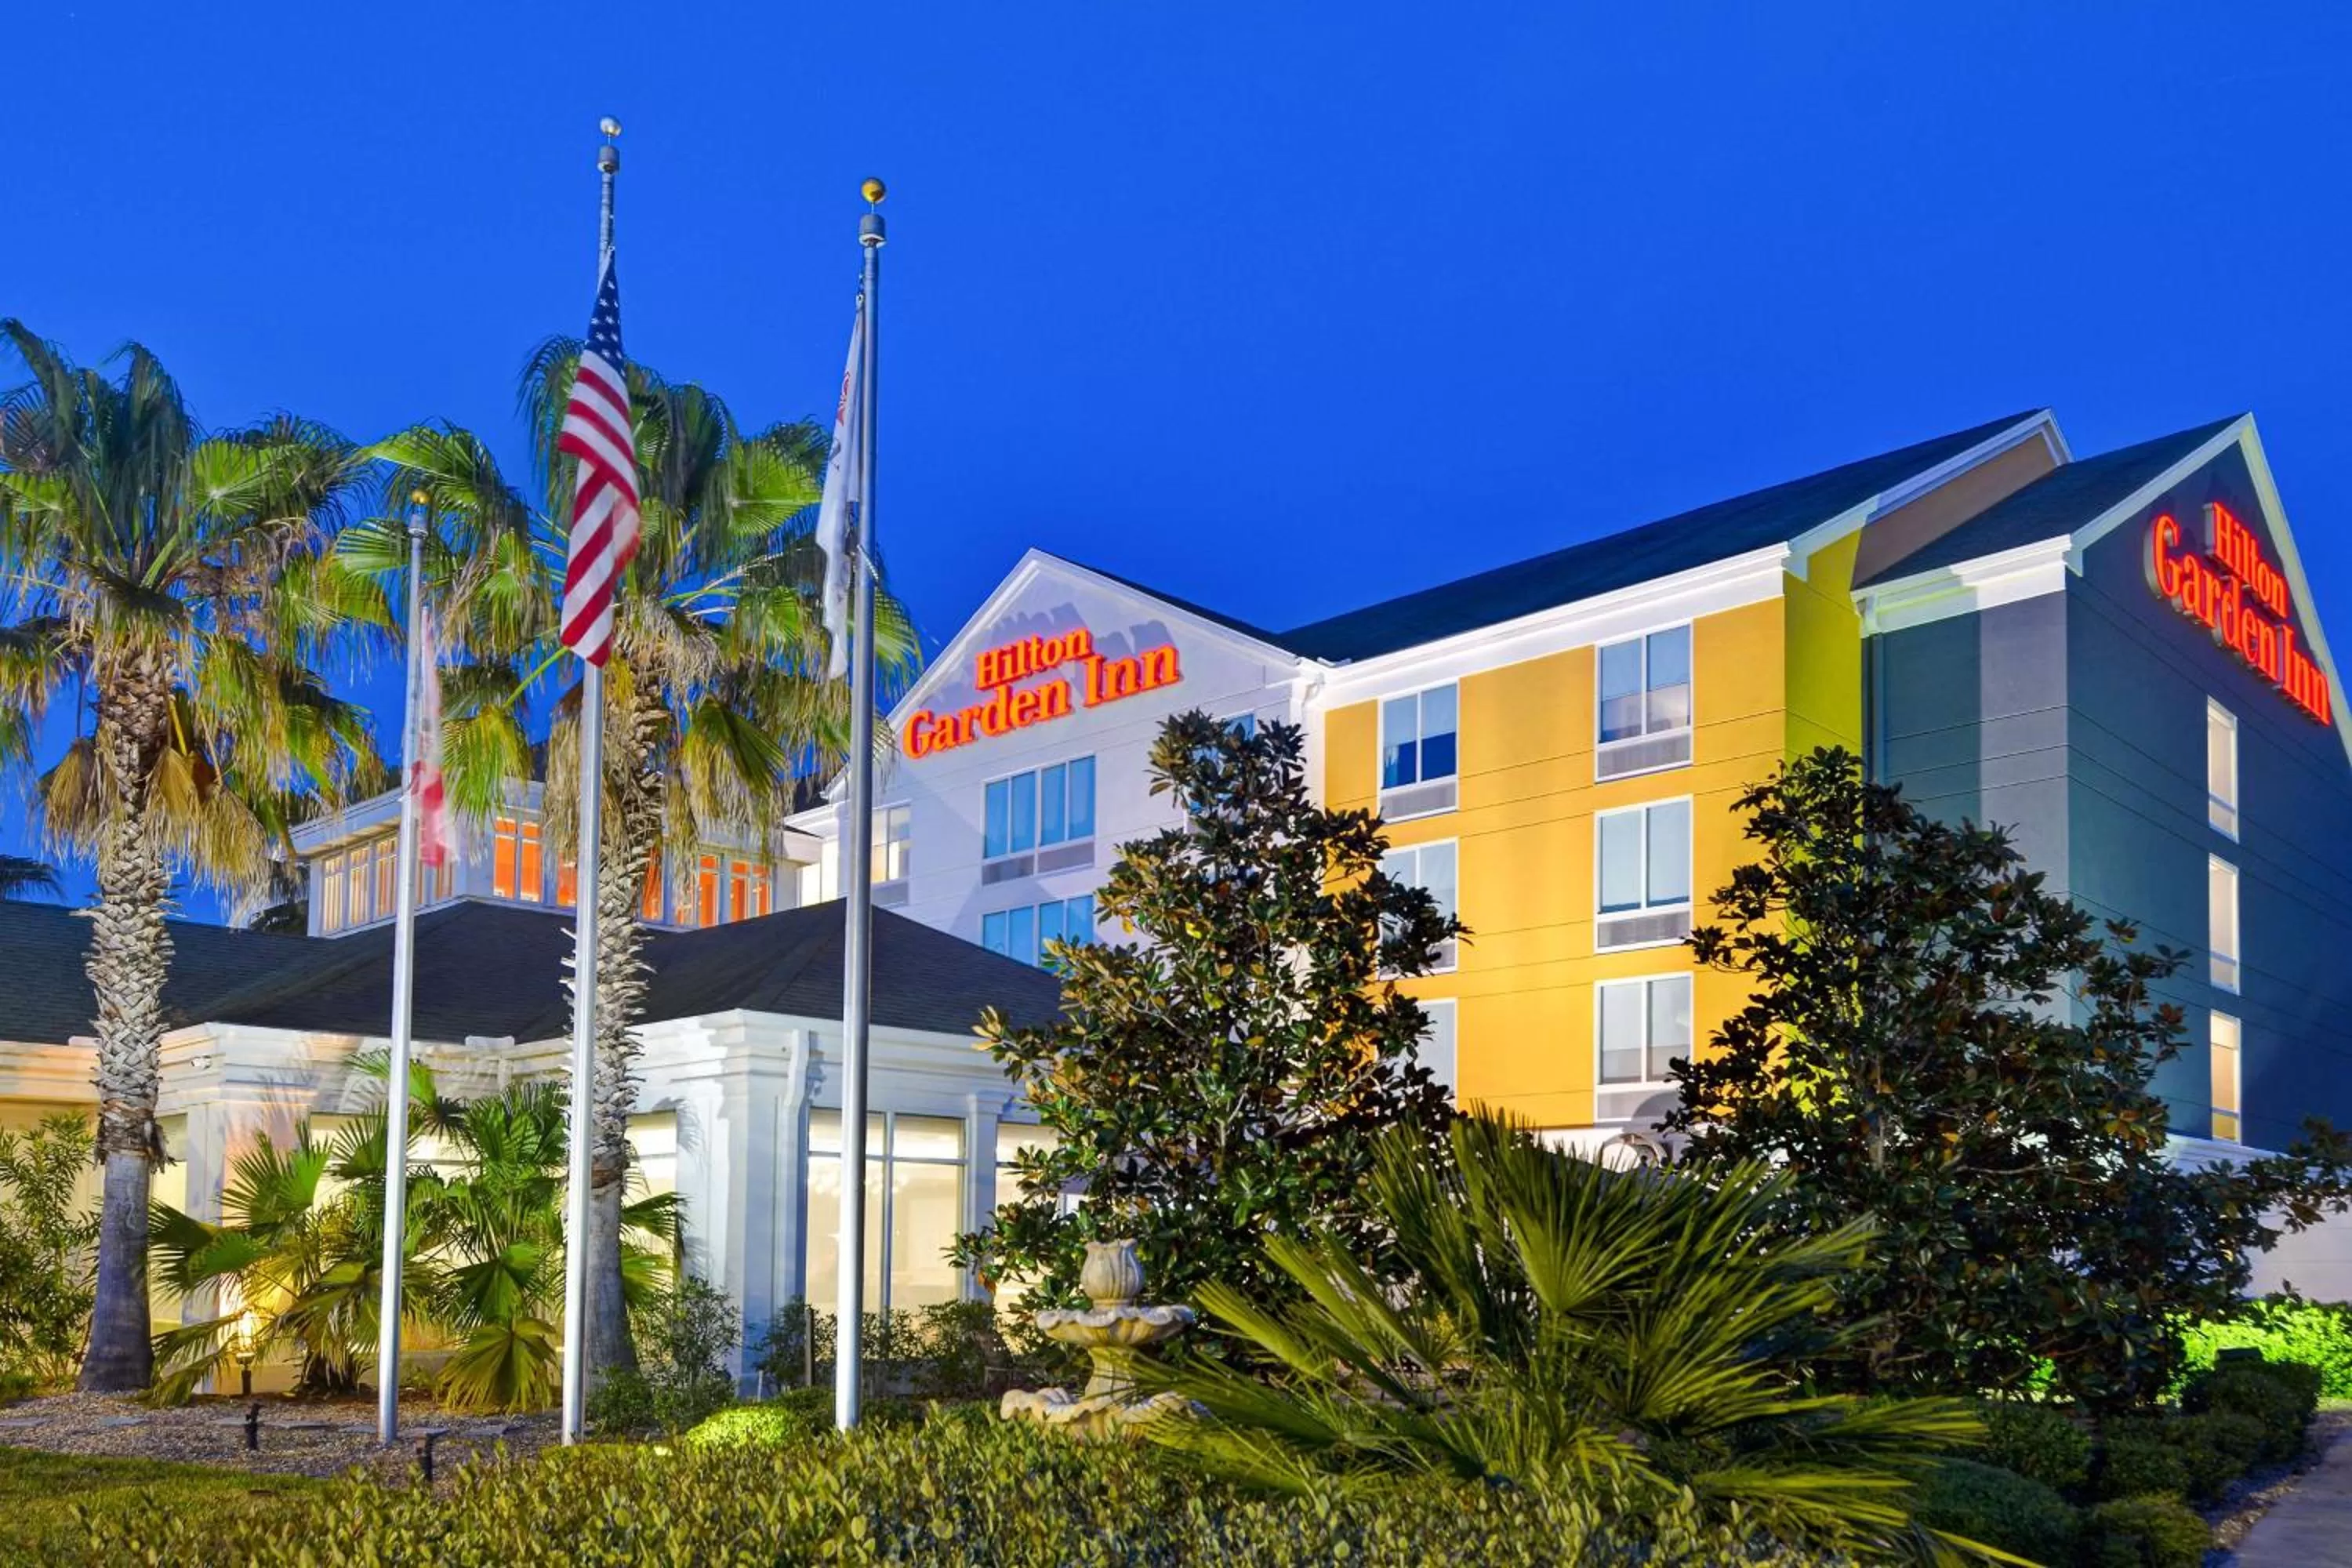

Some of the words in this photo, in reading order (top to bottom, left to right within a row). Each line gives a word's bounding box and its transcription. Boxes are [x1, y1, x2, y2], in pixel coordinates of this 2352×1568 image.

[2212, 502, 2288, 619] Hilton
[975, 626, 1093, 691] Hilton
[2152, 514, 2278, 681] Garden
[2281, 624, 2331, 726] Inn
[902, 679, 1072, 759] Garden
[1083, 644, 1181, 708] Inn
